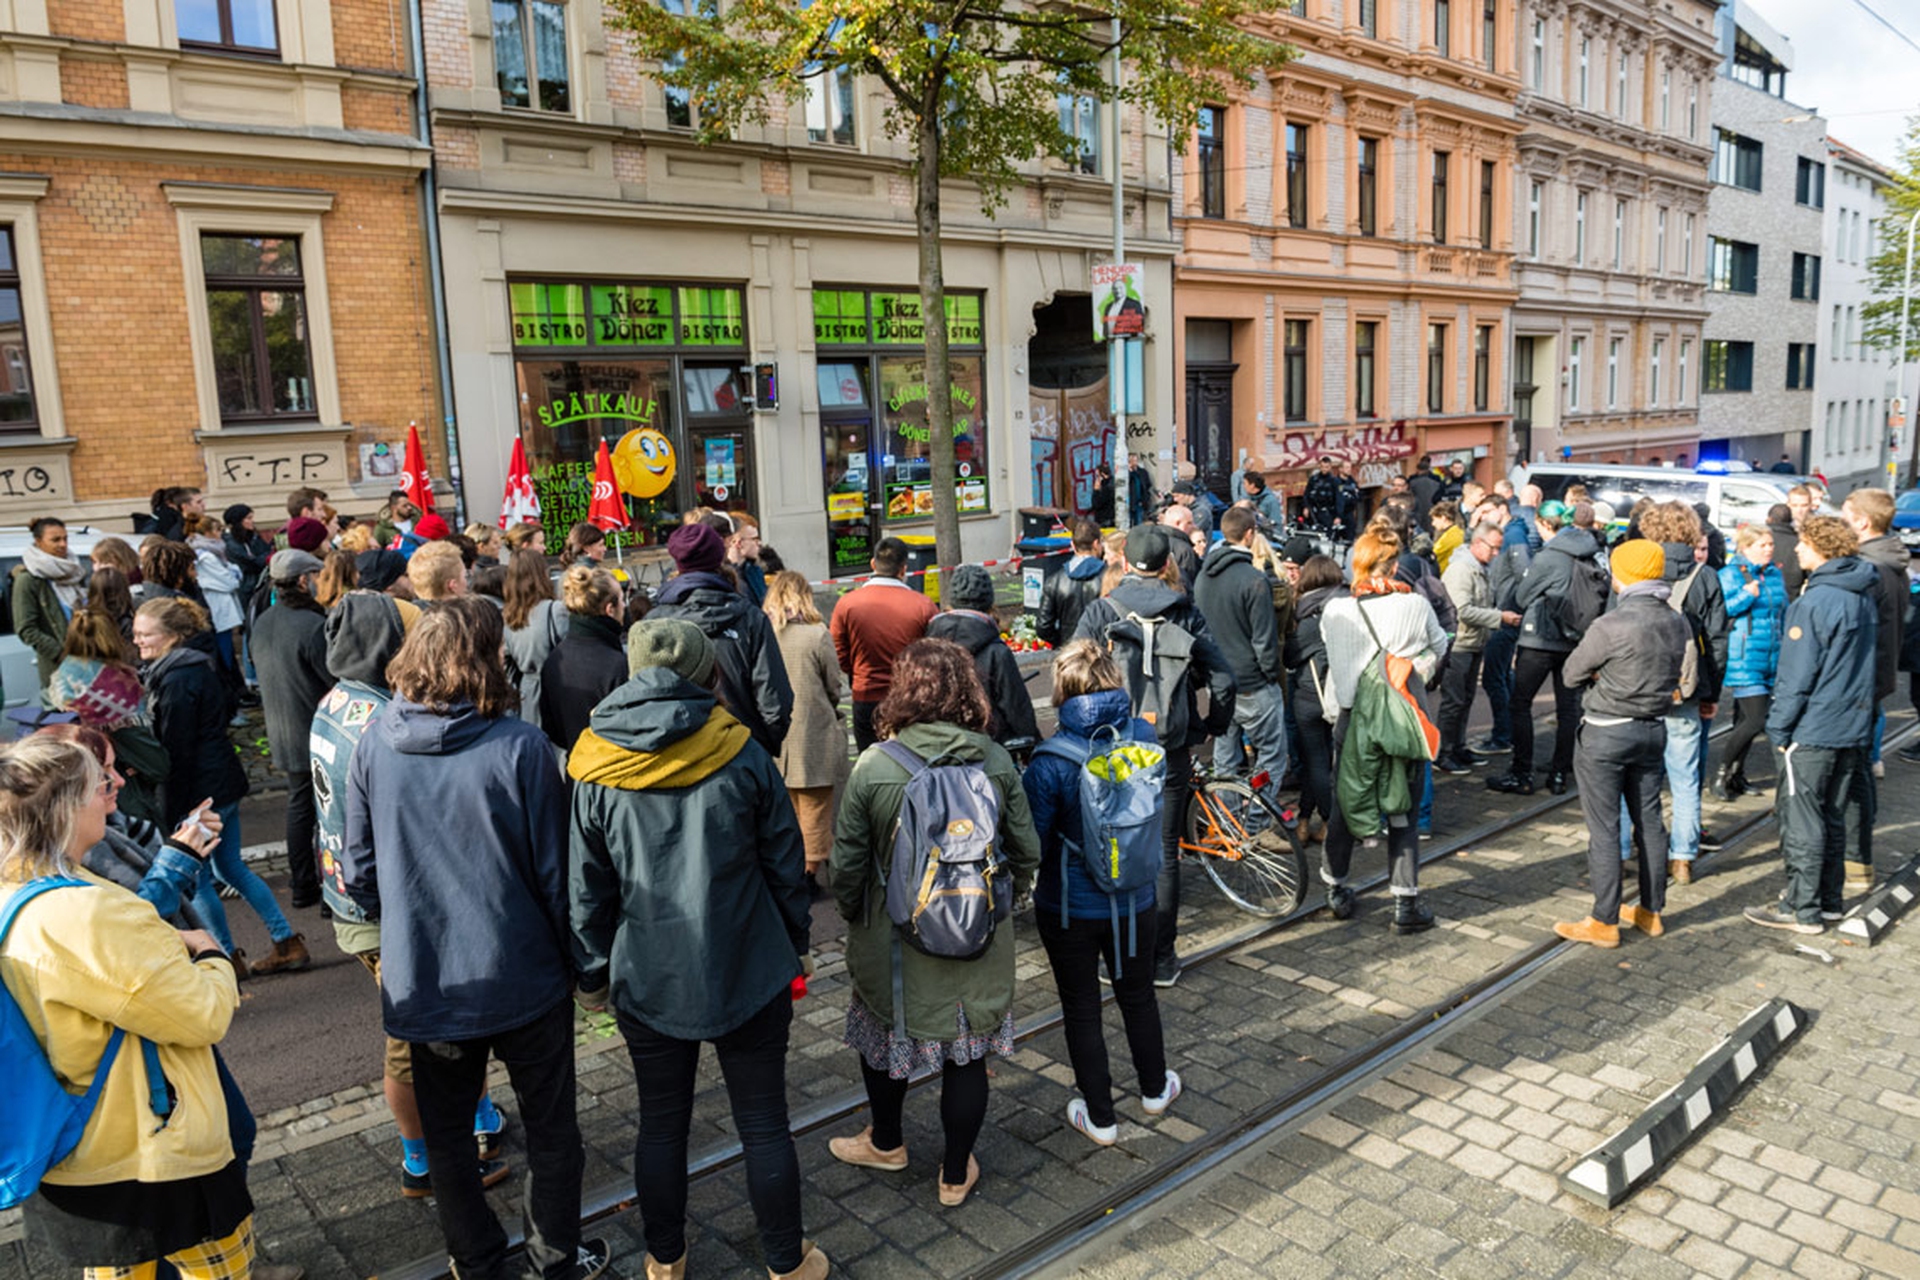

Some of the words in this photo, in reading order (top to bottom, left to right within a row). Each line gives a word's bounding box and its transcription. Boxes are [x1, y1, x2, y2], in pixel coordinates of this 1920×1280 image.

[607, 292, 659, 315] Kiez
[882, 298, 919, 318] Kiez
[515, 323, 585, 339] BISTRO
[601, 317, 667, 340] Döner
[683, 325, 742, 339] BISTRO
[815, 325, 867, 339] BISTRO
[538, 391, 657, 425] SPÄTKAUF
[538, 461, 592, 478] KAFFEE
[542, 524, 570, 540] TAB
